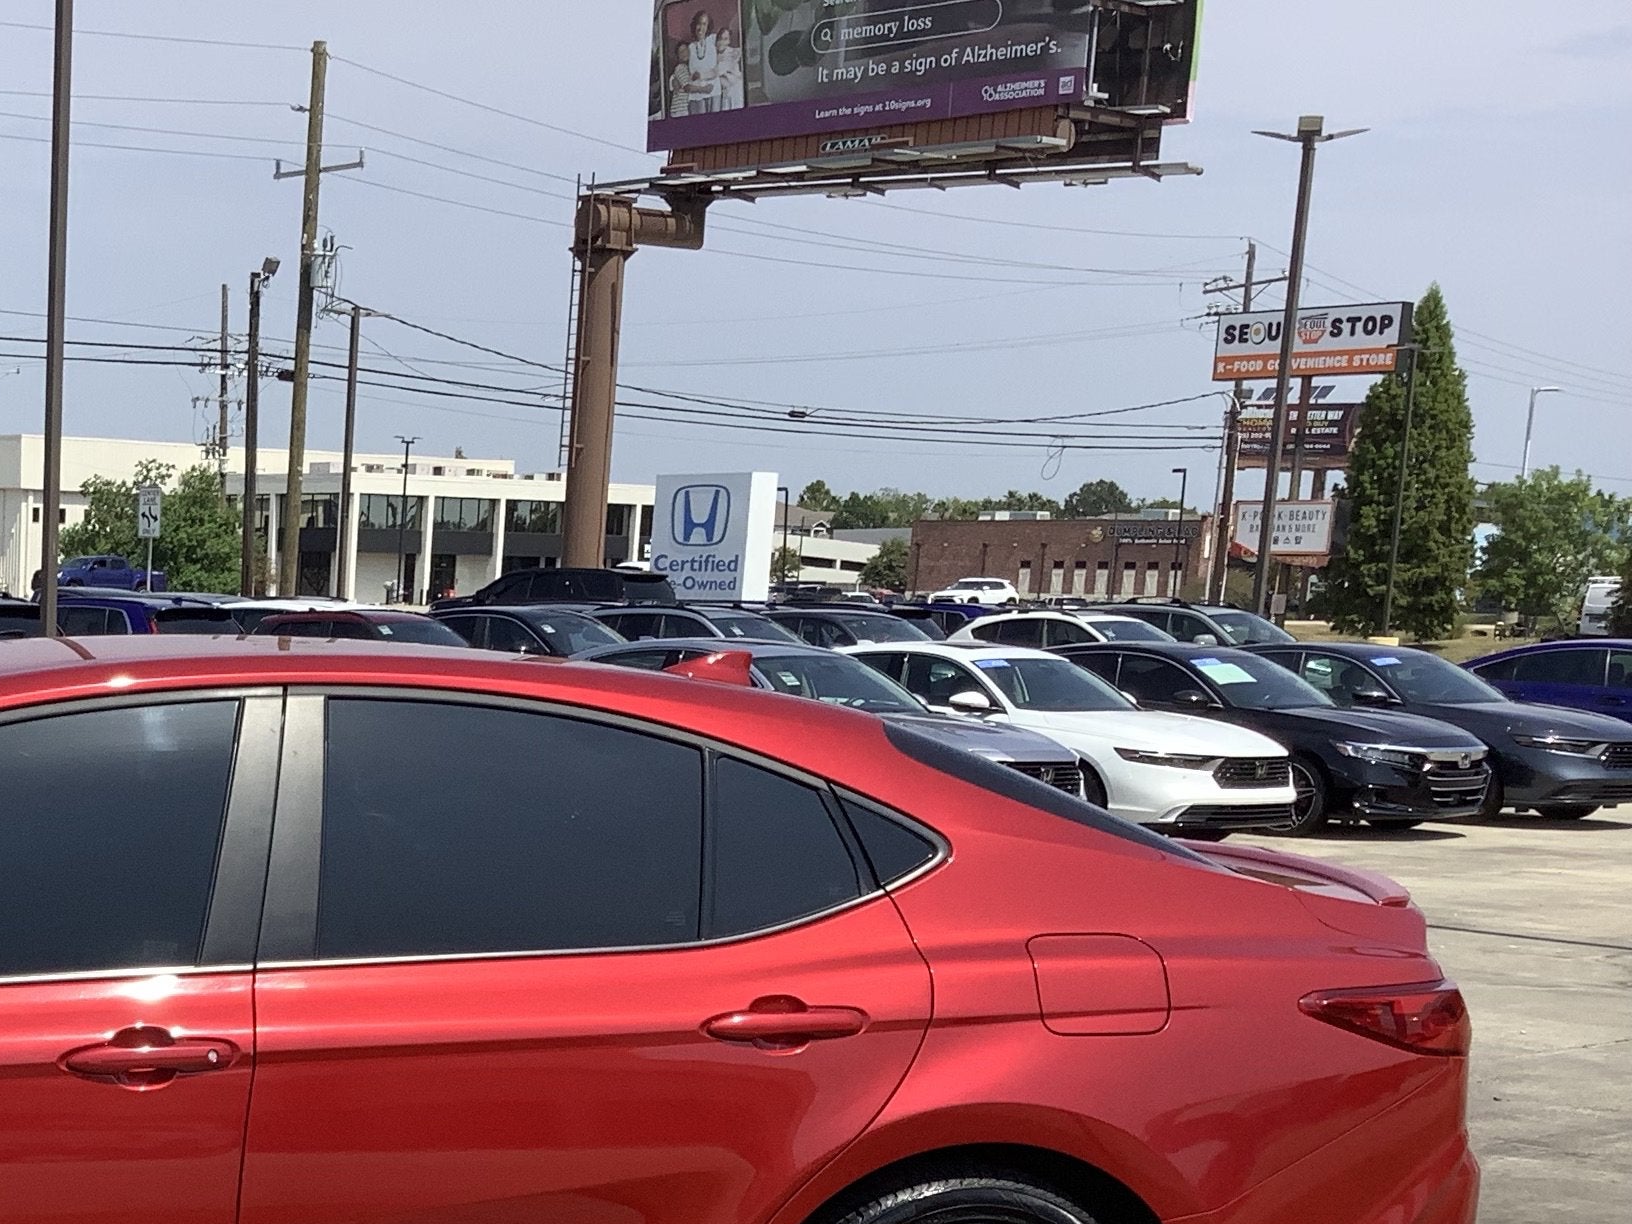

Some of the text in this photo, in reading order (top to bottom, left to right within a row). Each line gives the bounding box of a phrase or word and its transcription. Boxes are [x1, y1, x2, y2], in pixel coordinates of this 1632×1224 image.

[840, 15, 933, 40] memory loss
[818, 36, 1062, 83] It may be a sign of Alzheimer's.
[994, 88, 1045, 100] ASSOCIATION
[815, 98, 932, 119] Learn the signs at 10signs.org
[1223, 314, 1394, 345] SEOU STOP
[1217, 353, 1394, 374] K-FOOD COVENIENCE STORE
[1277, 510, 1327, 521] K-BEAUTY
[654, 554, 739, 572] Certified
[669, 577, 737, 591] e-Owned
